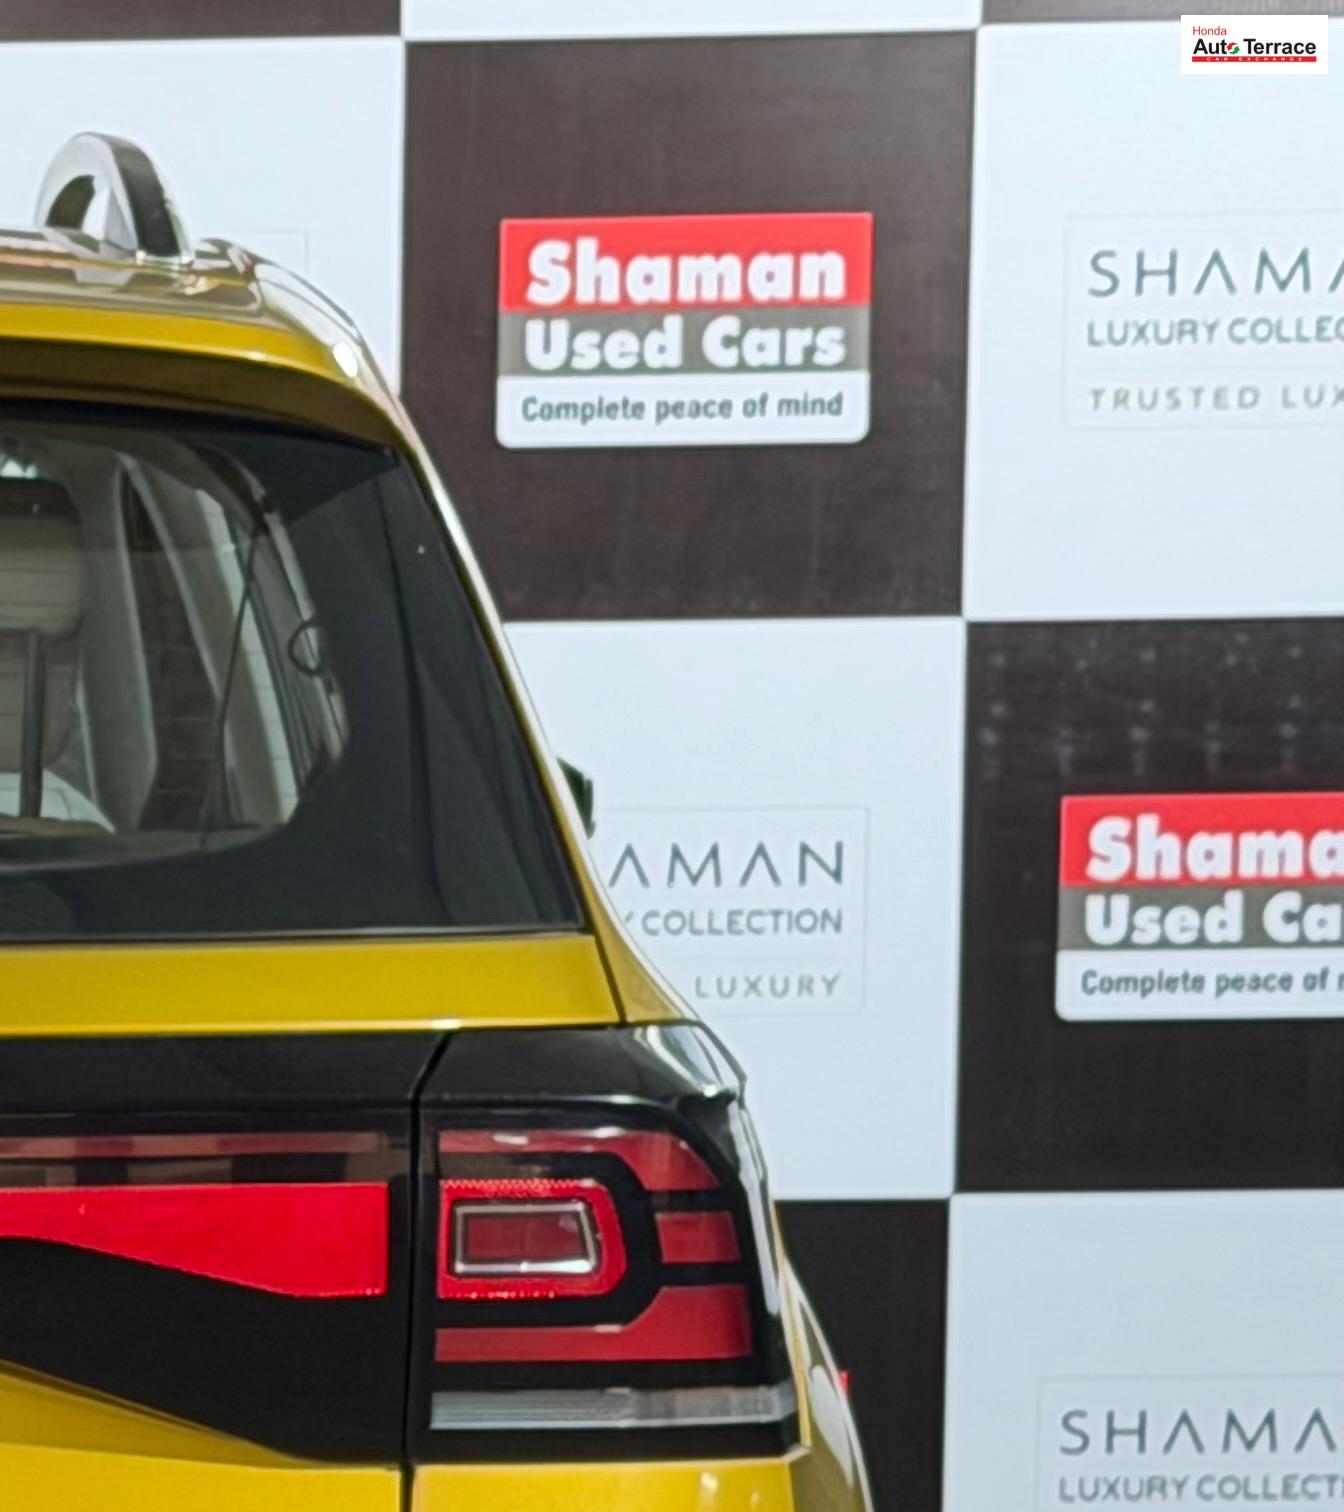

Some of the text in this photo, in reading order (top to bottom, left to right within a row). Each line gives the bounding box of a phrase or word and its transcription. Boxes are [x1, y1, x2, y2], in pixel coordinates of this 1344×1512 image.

[525, 236, 847, 305] Shaman
[525, 314, 846, 370] Used Cars
[1087, 318, 1220, 347] LUXURY
[521, 391, 845, 426] Complete peace of mind
[1089, 385, 1261, 411] TRUSTED
[641, 908, 843, 936] COLLECTION
[1085, 890, 1244, 945] Used
[695, 975, 841, 999] LUXURY
[1081, 969, 1205, 999] Complete
[1215, 972, 1293, 998] peace
[1303, 966, 1330, 992] of
[1058, 1475, 1189, 1503] LUXURY
